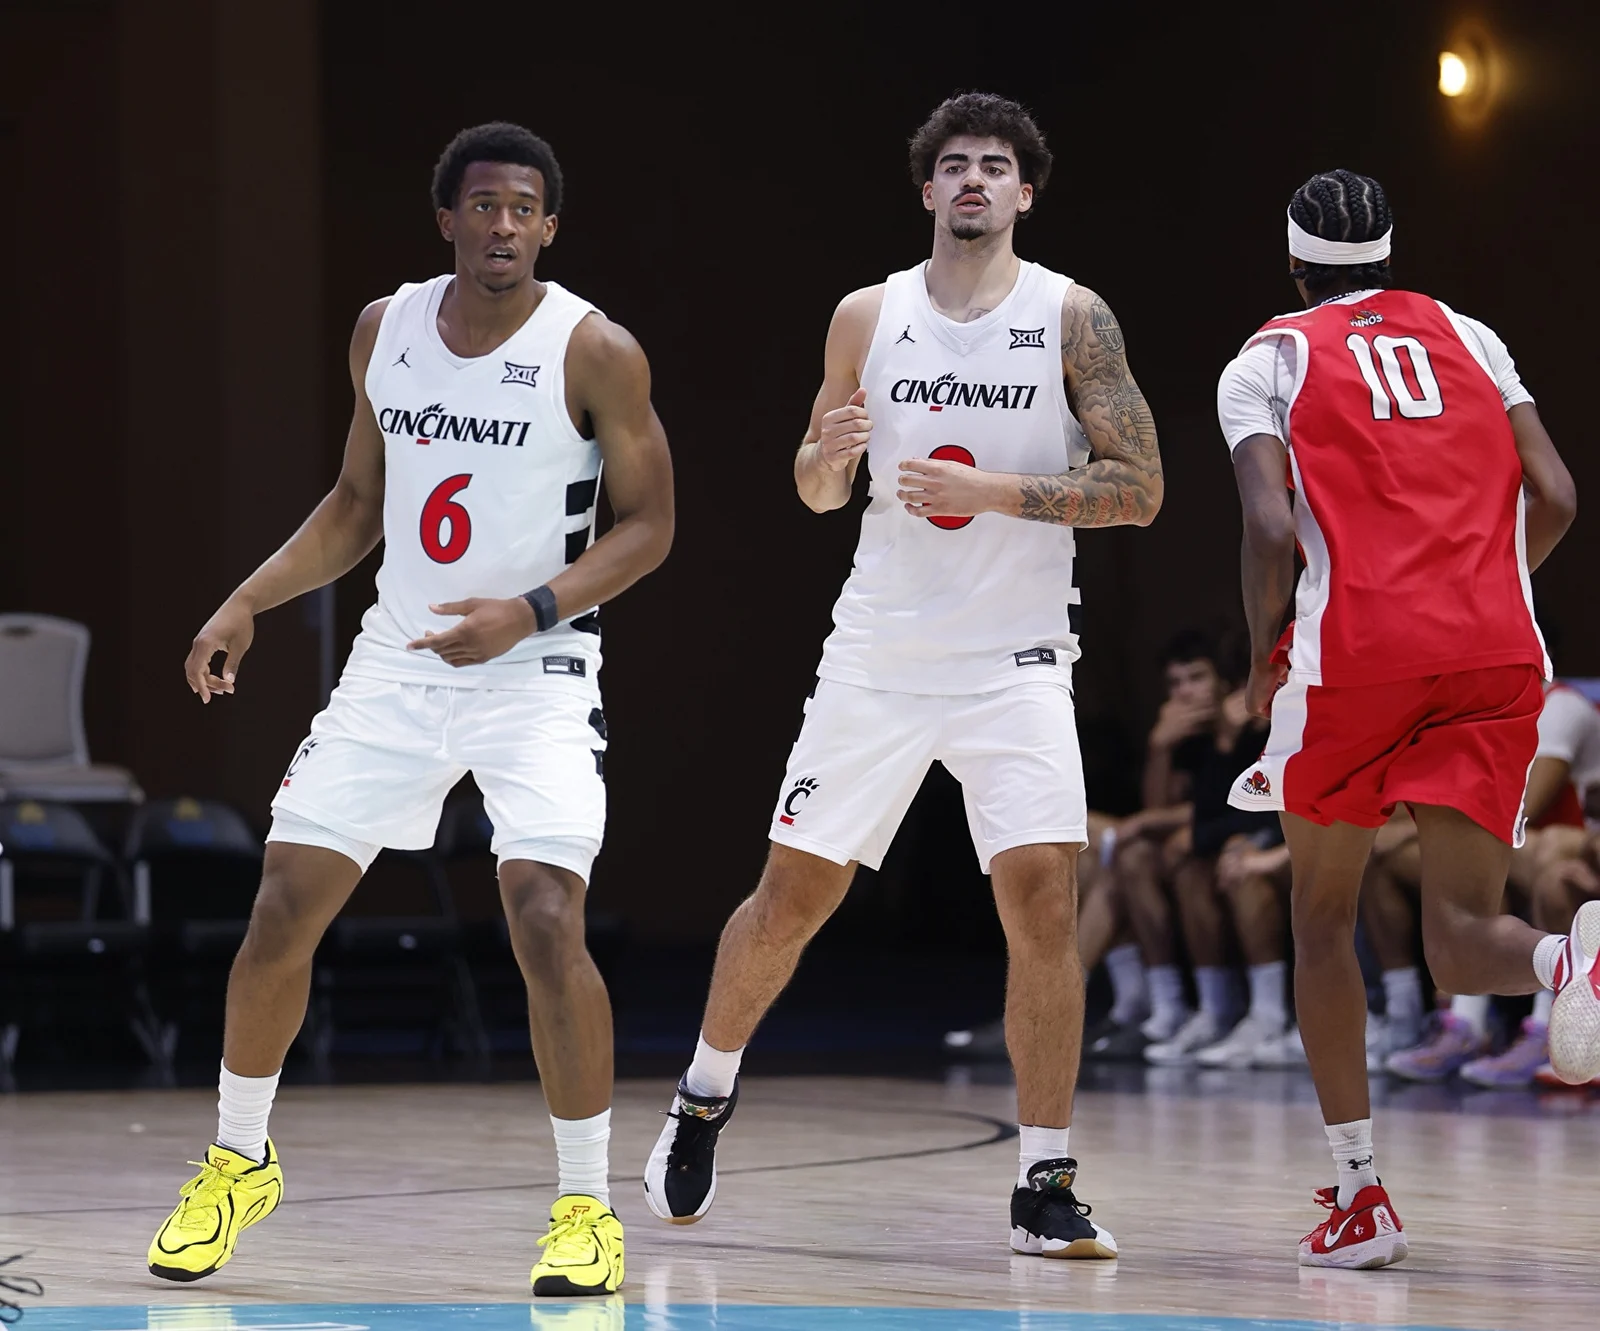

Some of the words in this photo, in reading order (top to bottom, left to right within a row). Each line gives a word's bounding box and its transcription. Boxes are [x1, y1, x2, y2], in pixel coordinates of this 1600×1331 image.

[1350, 314, 1384, 328] DINOS
[1009, 327, 1045, 350] XII
[501, 361, 541, 388] XII
[1346, 333, 1444, 421] 10
[890, 373, 1038, 410] CINCINNATI
[379, 404, 531, 446] CINCINNATI
[419, 473, 473, 564] 6
[574, 661, 580, 671] L
[1041, 651, 1053, 660] XL
